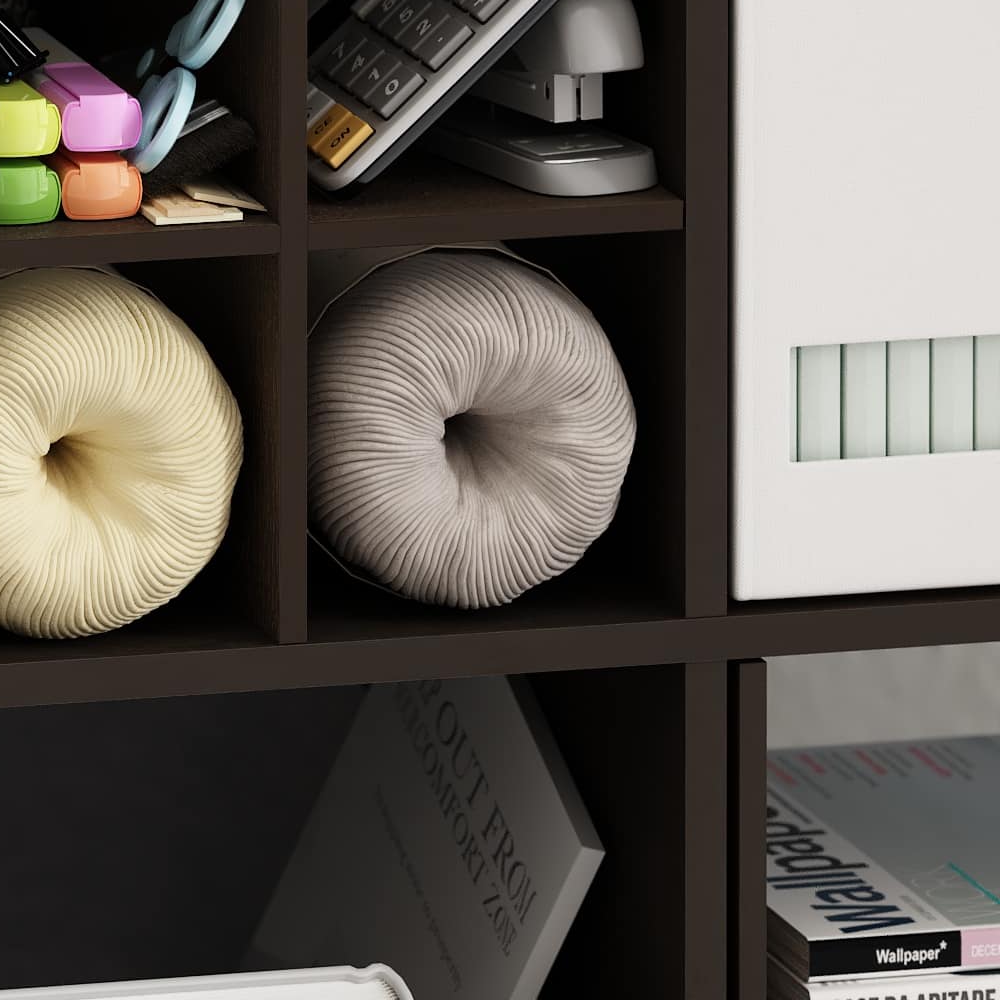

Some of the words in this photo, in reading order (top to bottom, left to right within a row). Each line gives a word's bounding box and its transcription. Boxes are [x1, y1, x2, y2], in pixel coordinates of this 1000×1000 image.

[416, 19, 431, 35] 2
[435, 701, 489, 807] OUT
[482, 800, 537, 924] FROM
[767, 806, 916, 934] Wallpap
